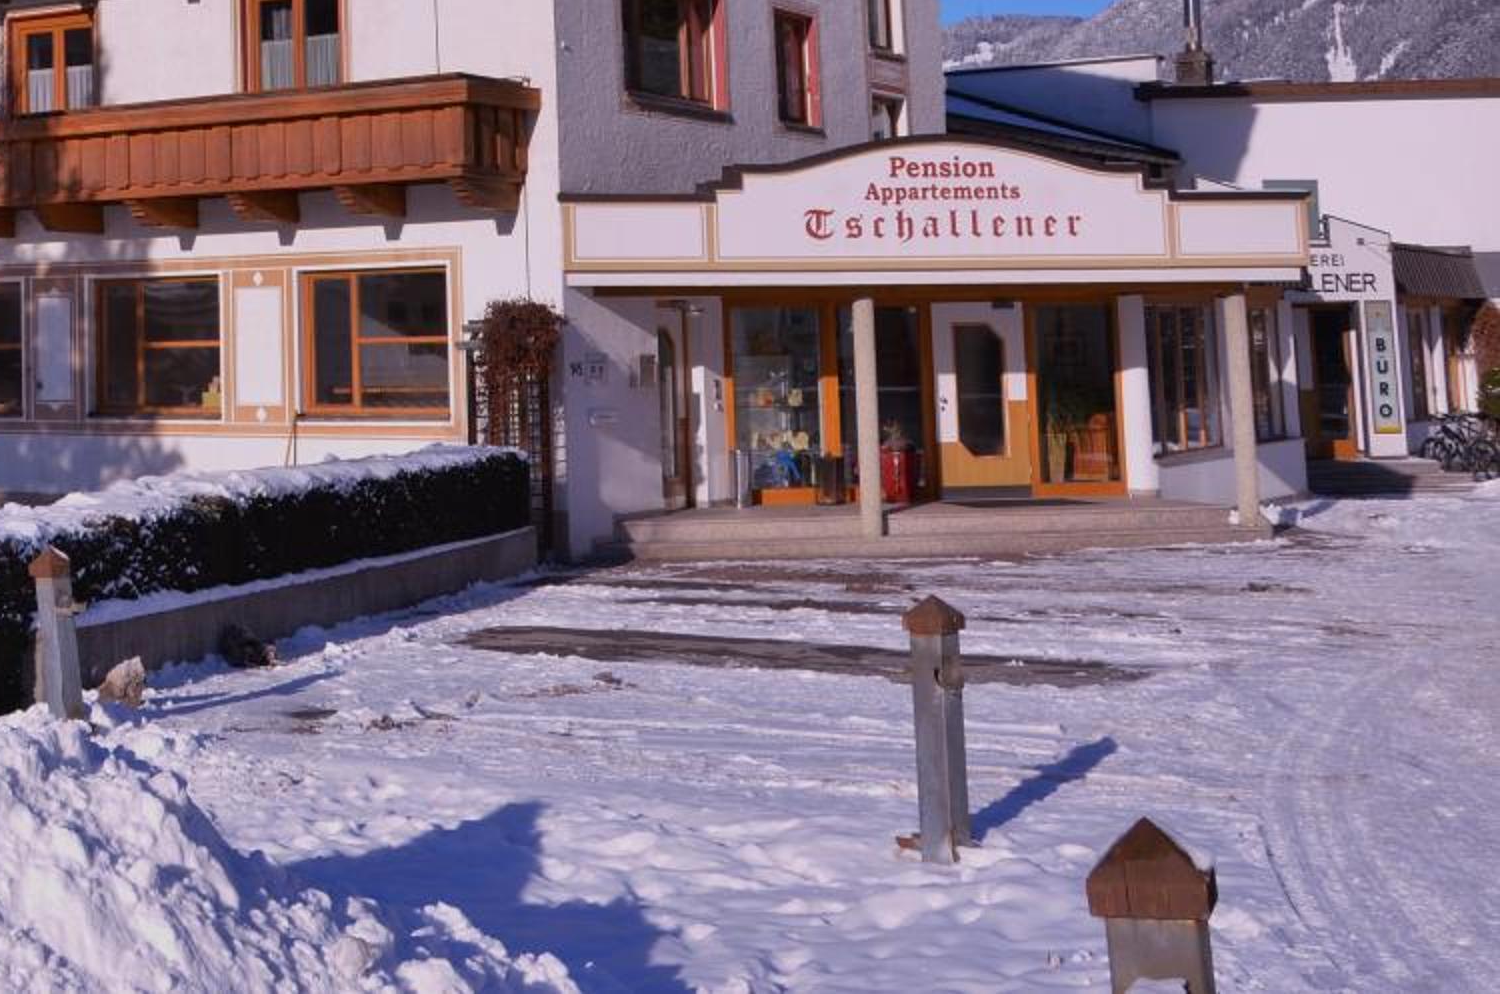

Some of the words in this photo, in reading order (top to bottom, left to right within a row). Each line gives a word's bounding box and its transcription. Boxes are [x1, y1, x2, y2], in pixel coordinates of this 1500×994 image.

[889, 156, 995, 178] Pension
[865, 183, 1020, 205] Appartements
[804, 209, 1082, 242] Tschallener
